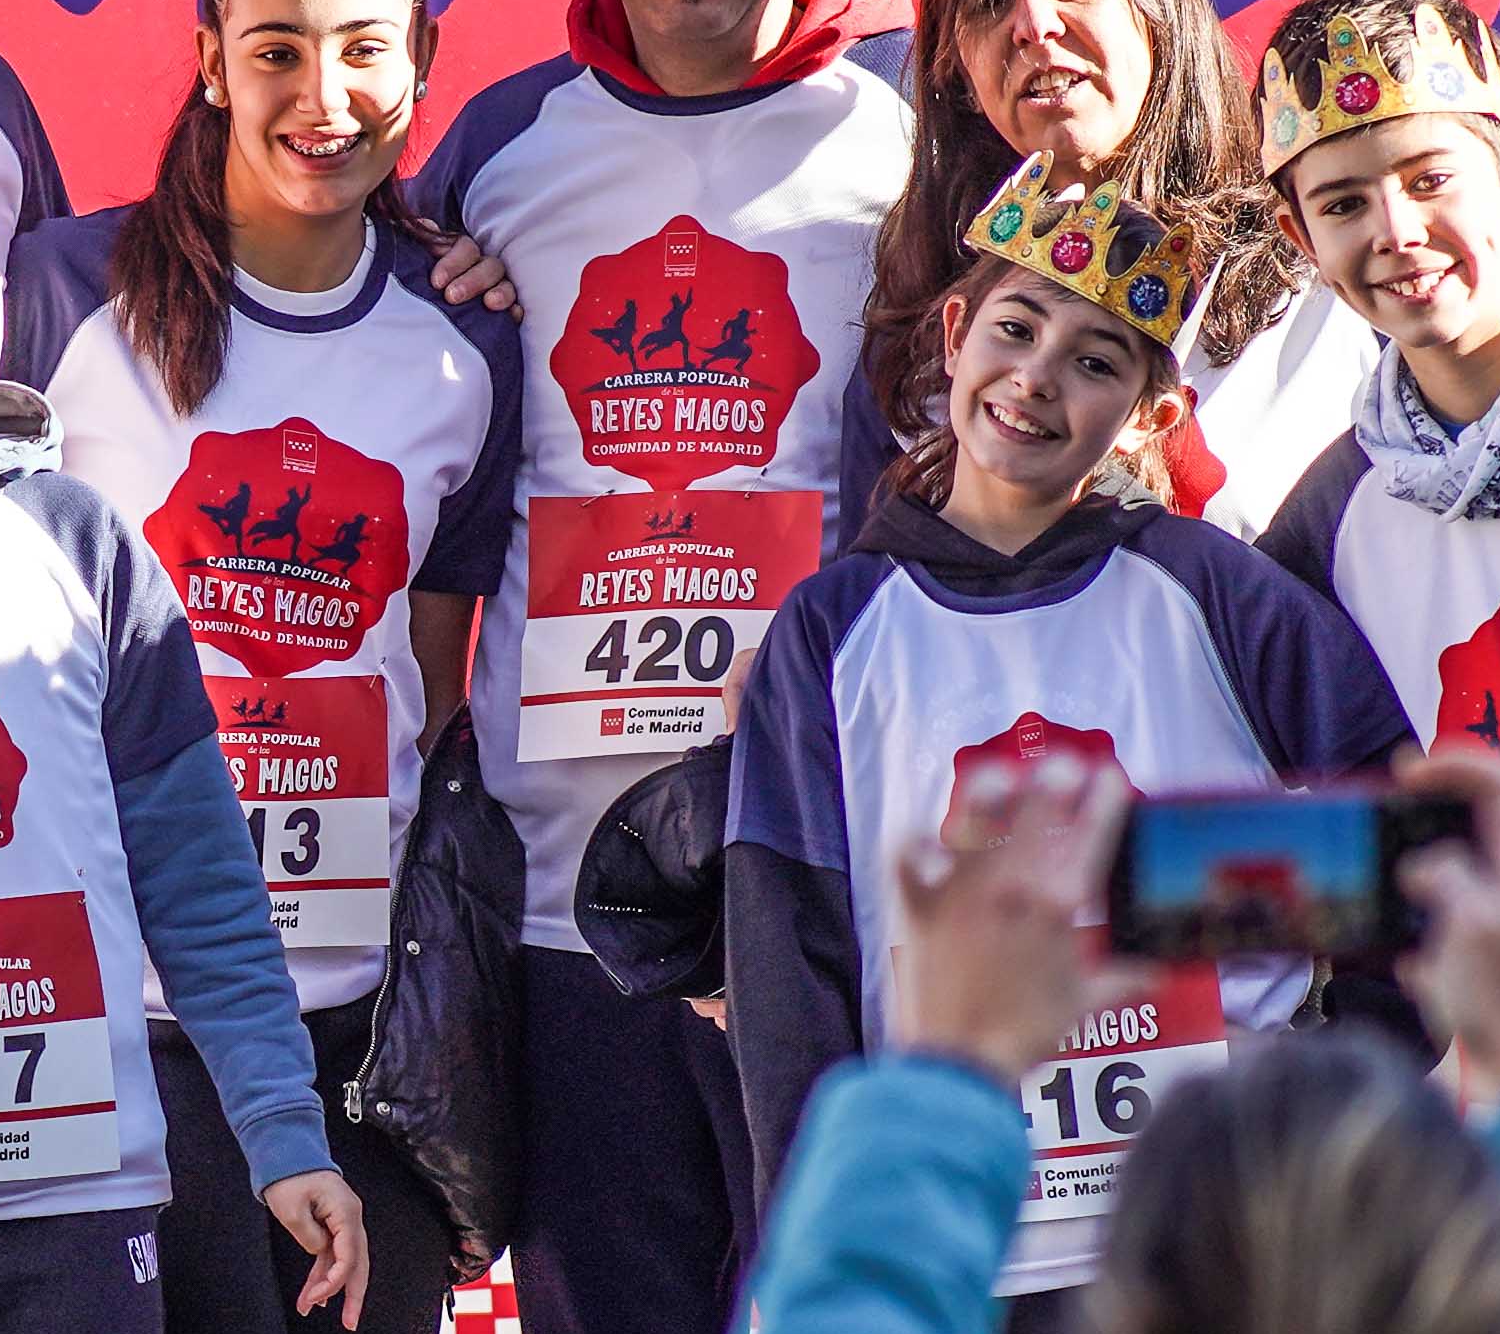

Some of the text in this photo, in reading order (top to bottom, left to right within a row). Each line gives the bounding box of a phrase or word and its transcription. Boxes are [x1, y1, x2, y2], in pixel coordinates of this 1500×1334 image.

[604, 371, 750, 389] CARRERA POPULAR
[590, 397, 767, 434] REYES MAGOS
[592, 441, 763, 456] COMUNIDAD DE MADRID
[607, 543, 735, 562] CARRERA POPULAR
[206, 555, 351, 592] CARRERA POPULAR
[579, 567, 757, 608] REYES MAGOS
[187, 574, 360, 628] REYES MAGOS
[276, 632, 294, 645] DE
[296, 634, 349, 651] MADRID
[584, 615, 735, 683] 420
[628, 706, 705, 718] Comunidad
[626, 721, 702, 735] de Madrid
[217, 732, 320, 748] RERA POPULAR
[258, 755, 338, 795] MAGOS
[248, 807, 321, 877] 13
[272, 917, 299, 929] drid
[1038, 1061, 1153, 1140] 16
[1044, 1163, 1121, 1181] Comunid
[1046, 1180, 1115, 1199] de Mad
